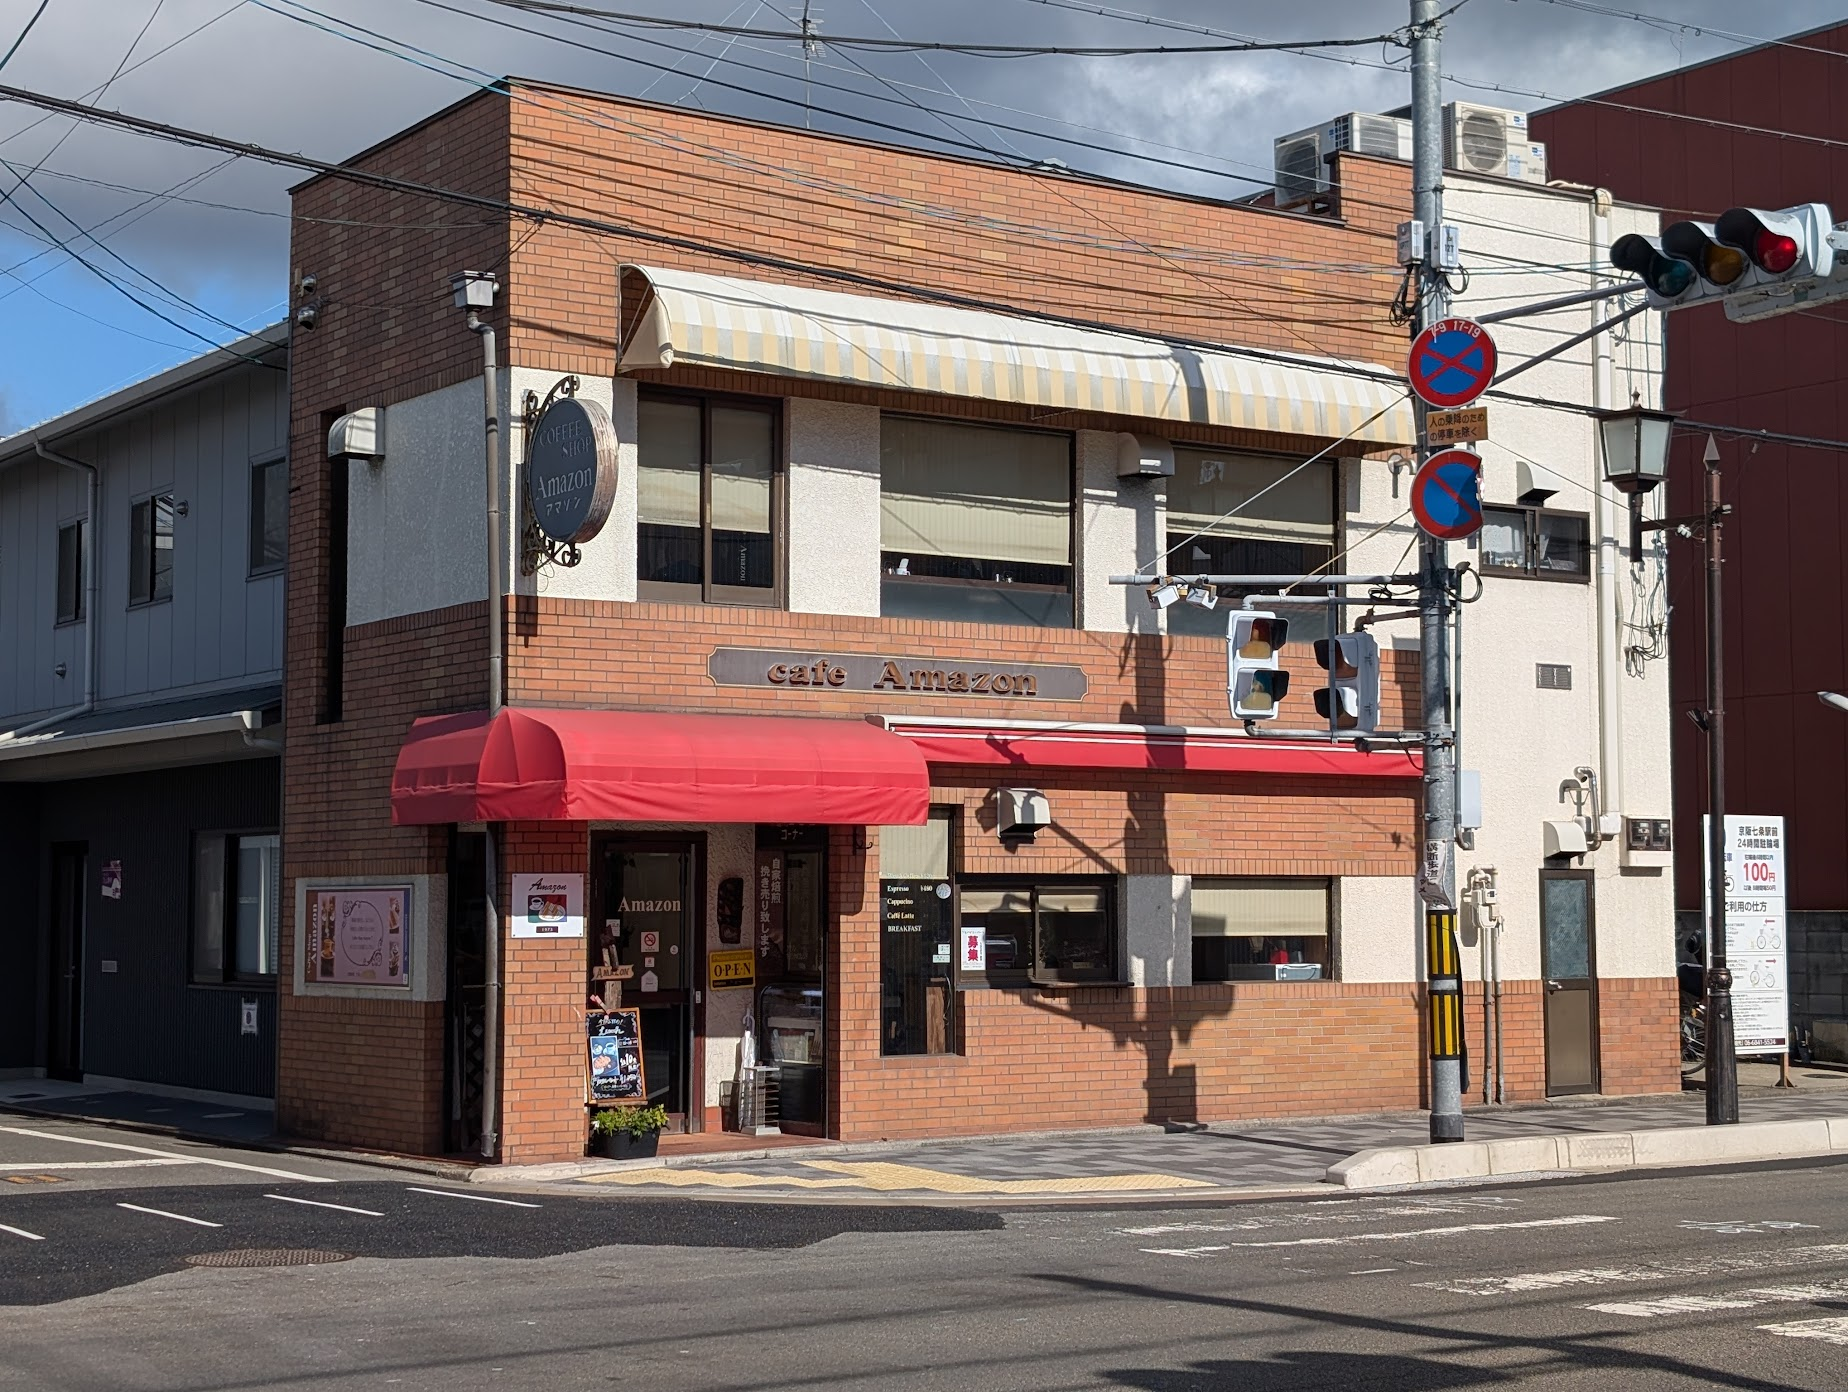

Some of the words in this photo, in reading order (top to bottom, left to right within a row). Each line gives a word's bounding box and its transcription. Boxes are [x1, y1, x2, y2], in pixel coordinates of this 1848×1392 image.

[1453, 321, 1481, 338] 17-19
[1429, 412, 1485, 428] 人の乗降のため
[539, 420, 582, 447] COFFEE
[1430, 427, 1477, 441] の停車を除く
[562, 436, 592, 458] SHOP
[535, 467, 592, 500] Amazon
[767, 659, 848, 687] cafe
[873, 661, 1039, 695] Amazon
[1738, 826, 1778, 837] 京阪七条駅前
[1737, 838, 1779, 849] 24時間駐輪場
[529, 877, 567, 893] Amazon
[771, 858, 781, 904] 自家焙煎
[617, 896, 681, 912] Amazon
[760, 865, 770, 957] 挽き売り致します
[310, 904, 318, 964] Amazon
[967, 935, 978, 961] 募集
